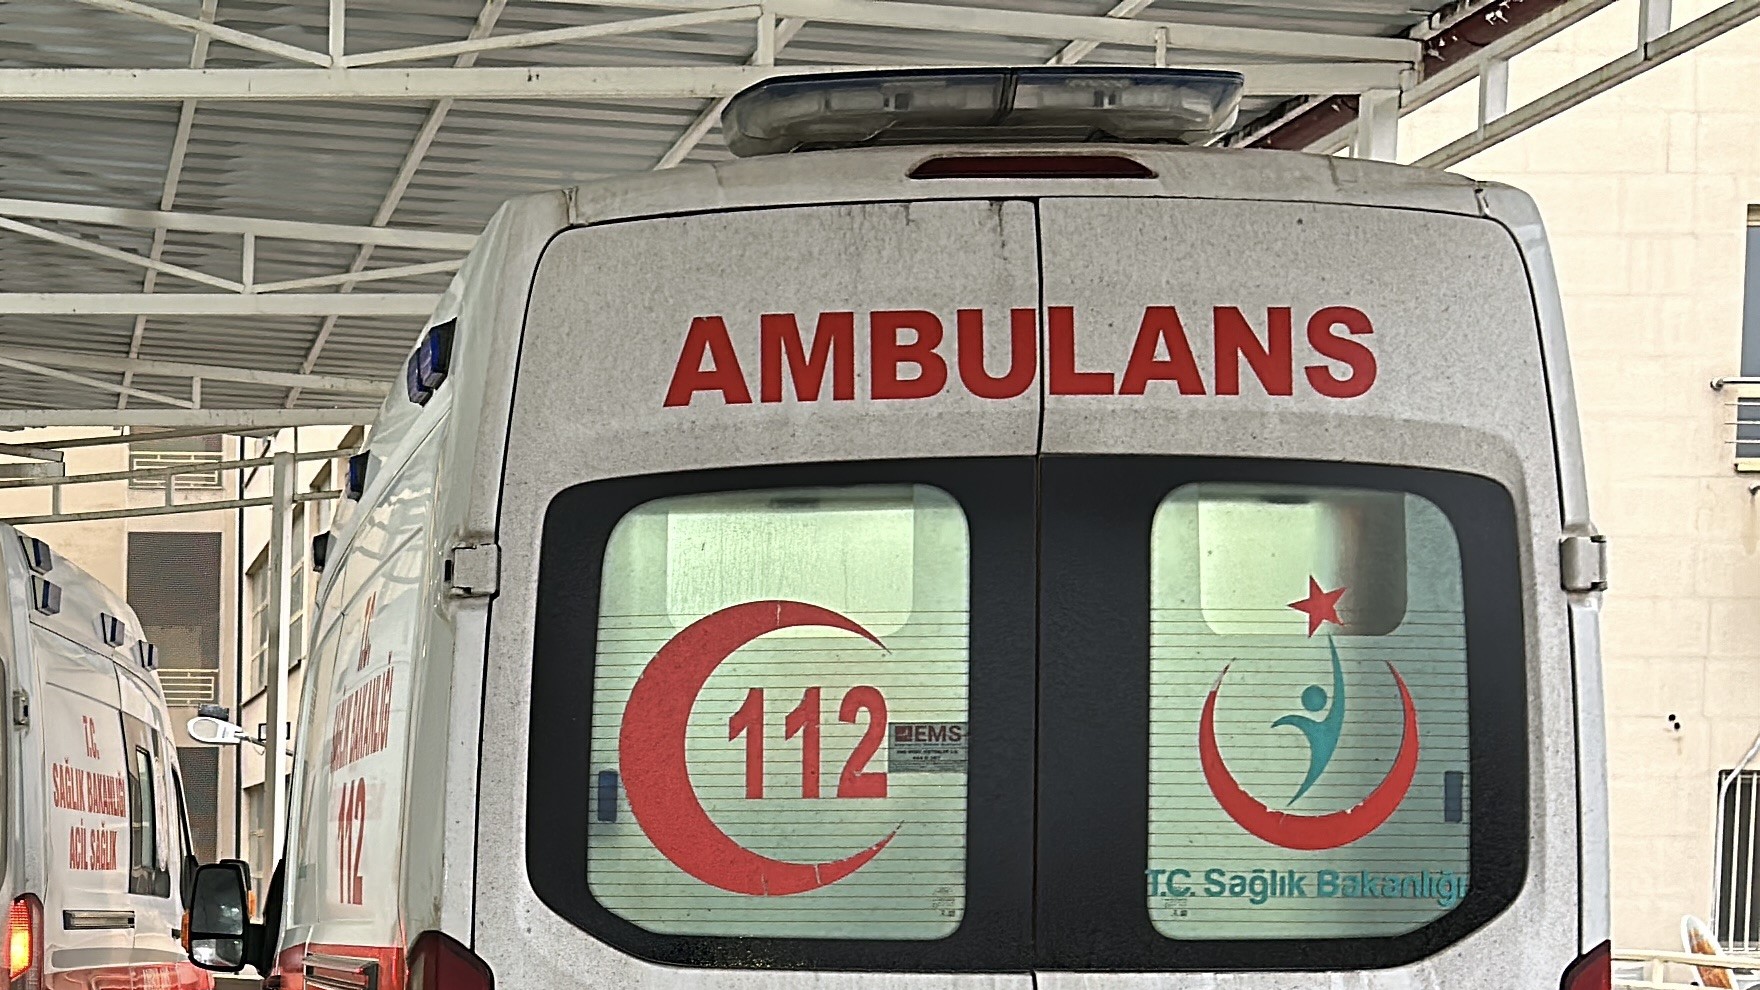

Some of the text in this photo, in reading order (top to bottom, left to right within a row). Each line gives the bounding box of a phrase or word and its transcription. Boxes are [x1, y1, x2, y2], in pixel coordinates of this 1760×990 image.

[662, 304, 1379, 408] AMBULANS
[726, 684, 888, 799] 112
[914, 725, 962, 742] EMS
[52, 757, 86, 812] SAĞLIK
[69, 818, 118, 871] ACİL SAĞLIK
[337, 776, 366, 906] 112
[1145, 868, 1468, 910] T.C. Sağlık Bakanlığı
